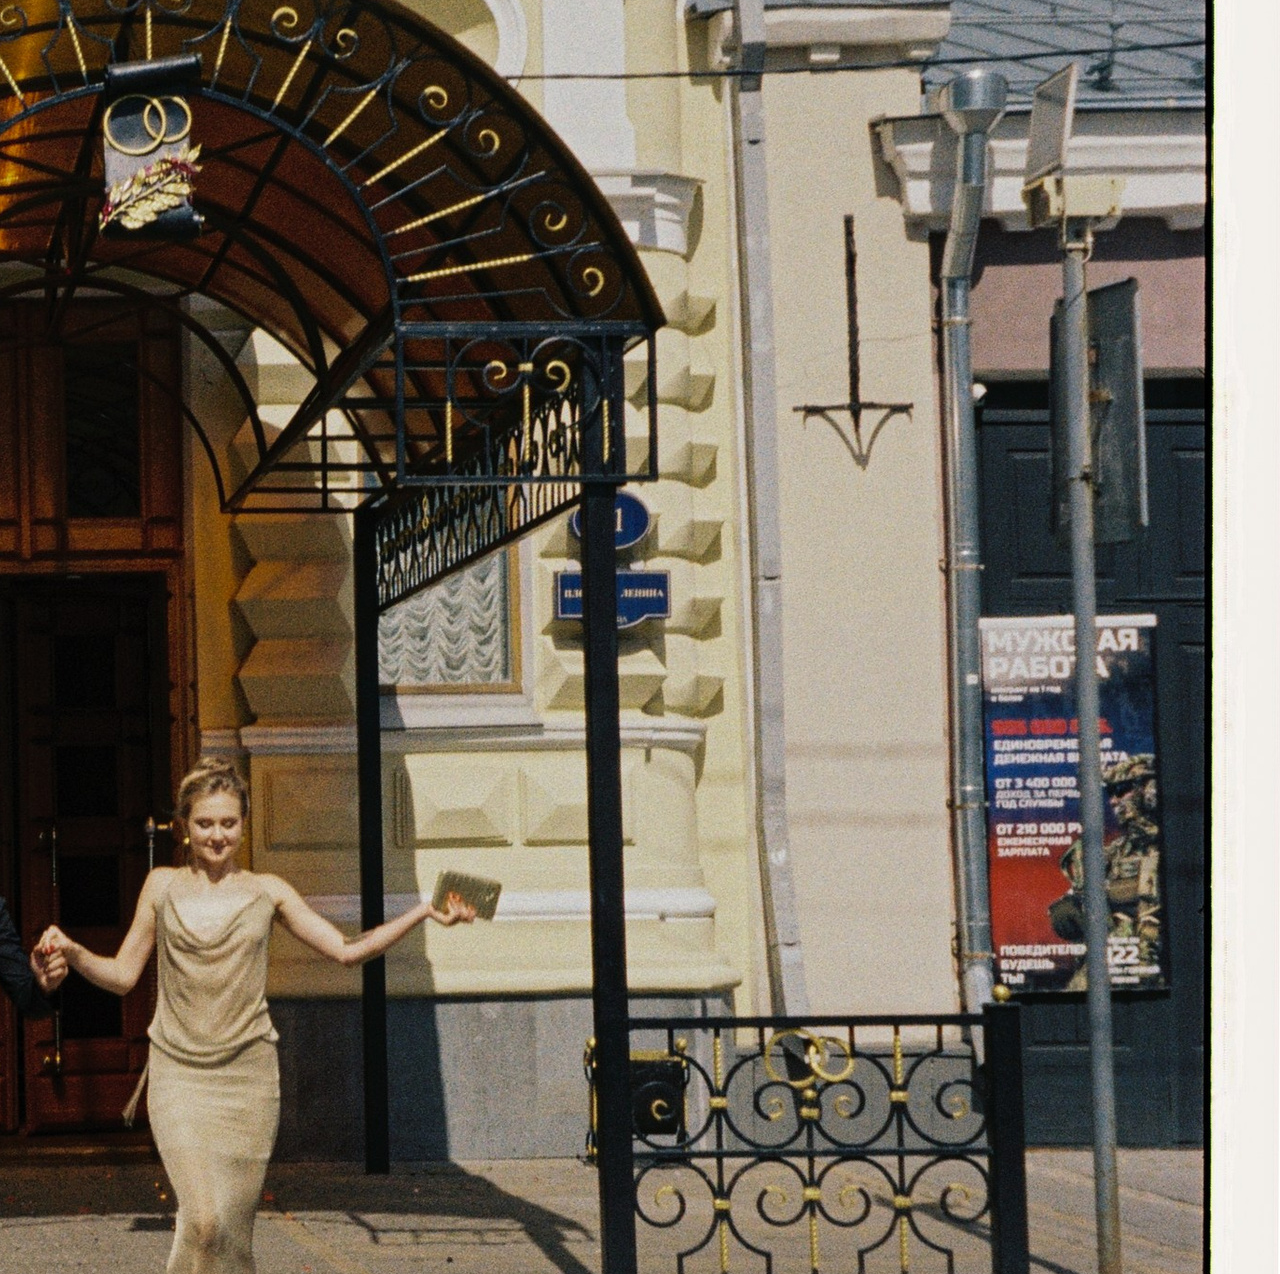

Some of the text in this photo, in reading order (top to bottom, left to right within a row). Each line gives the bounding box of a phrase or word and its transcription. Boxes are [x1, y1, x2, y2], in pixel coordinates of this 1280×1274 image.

[621, 588, 664, 598] ЛЕНИНА
[988, 628, 1138, 652] МУЖСАЯ
[989, 655, 1110, 678] РАБОА
[993, 738, 1112, 751] ЕДИНОВРЕМЕЯ
[994, 751, 1128, 765] ДЕНЕЖНАЯ ВАТА
[995, 778, 1012, 788] ОТ
[1051, 776, 1077, 787] 000
[1048, 789, 1081, 798] ПЕРВЫ
[996, 799, 1017, 809] ГОД
[996, 822, 1082, 835] ОТ 210 000 РУ
[997, 836, 1072, 847] ЕЖЕМЕСЯЧНАЯ
[998, 847, 1050, 858] ЗАРПЛАТА
[1000, 958, 1055, 971] БУДЕШЬ
